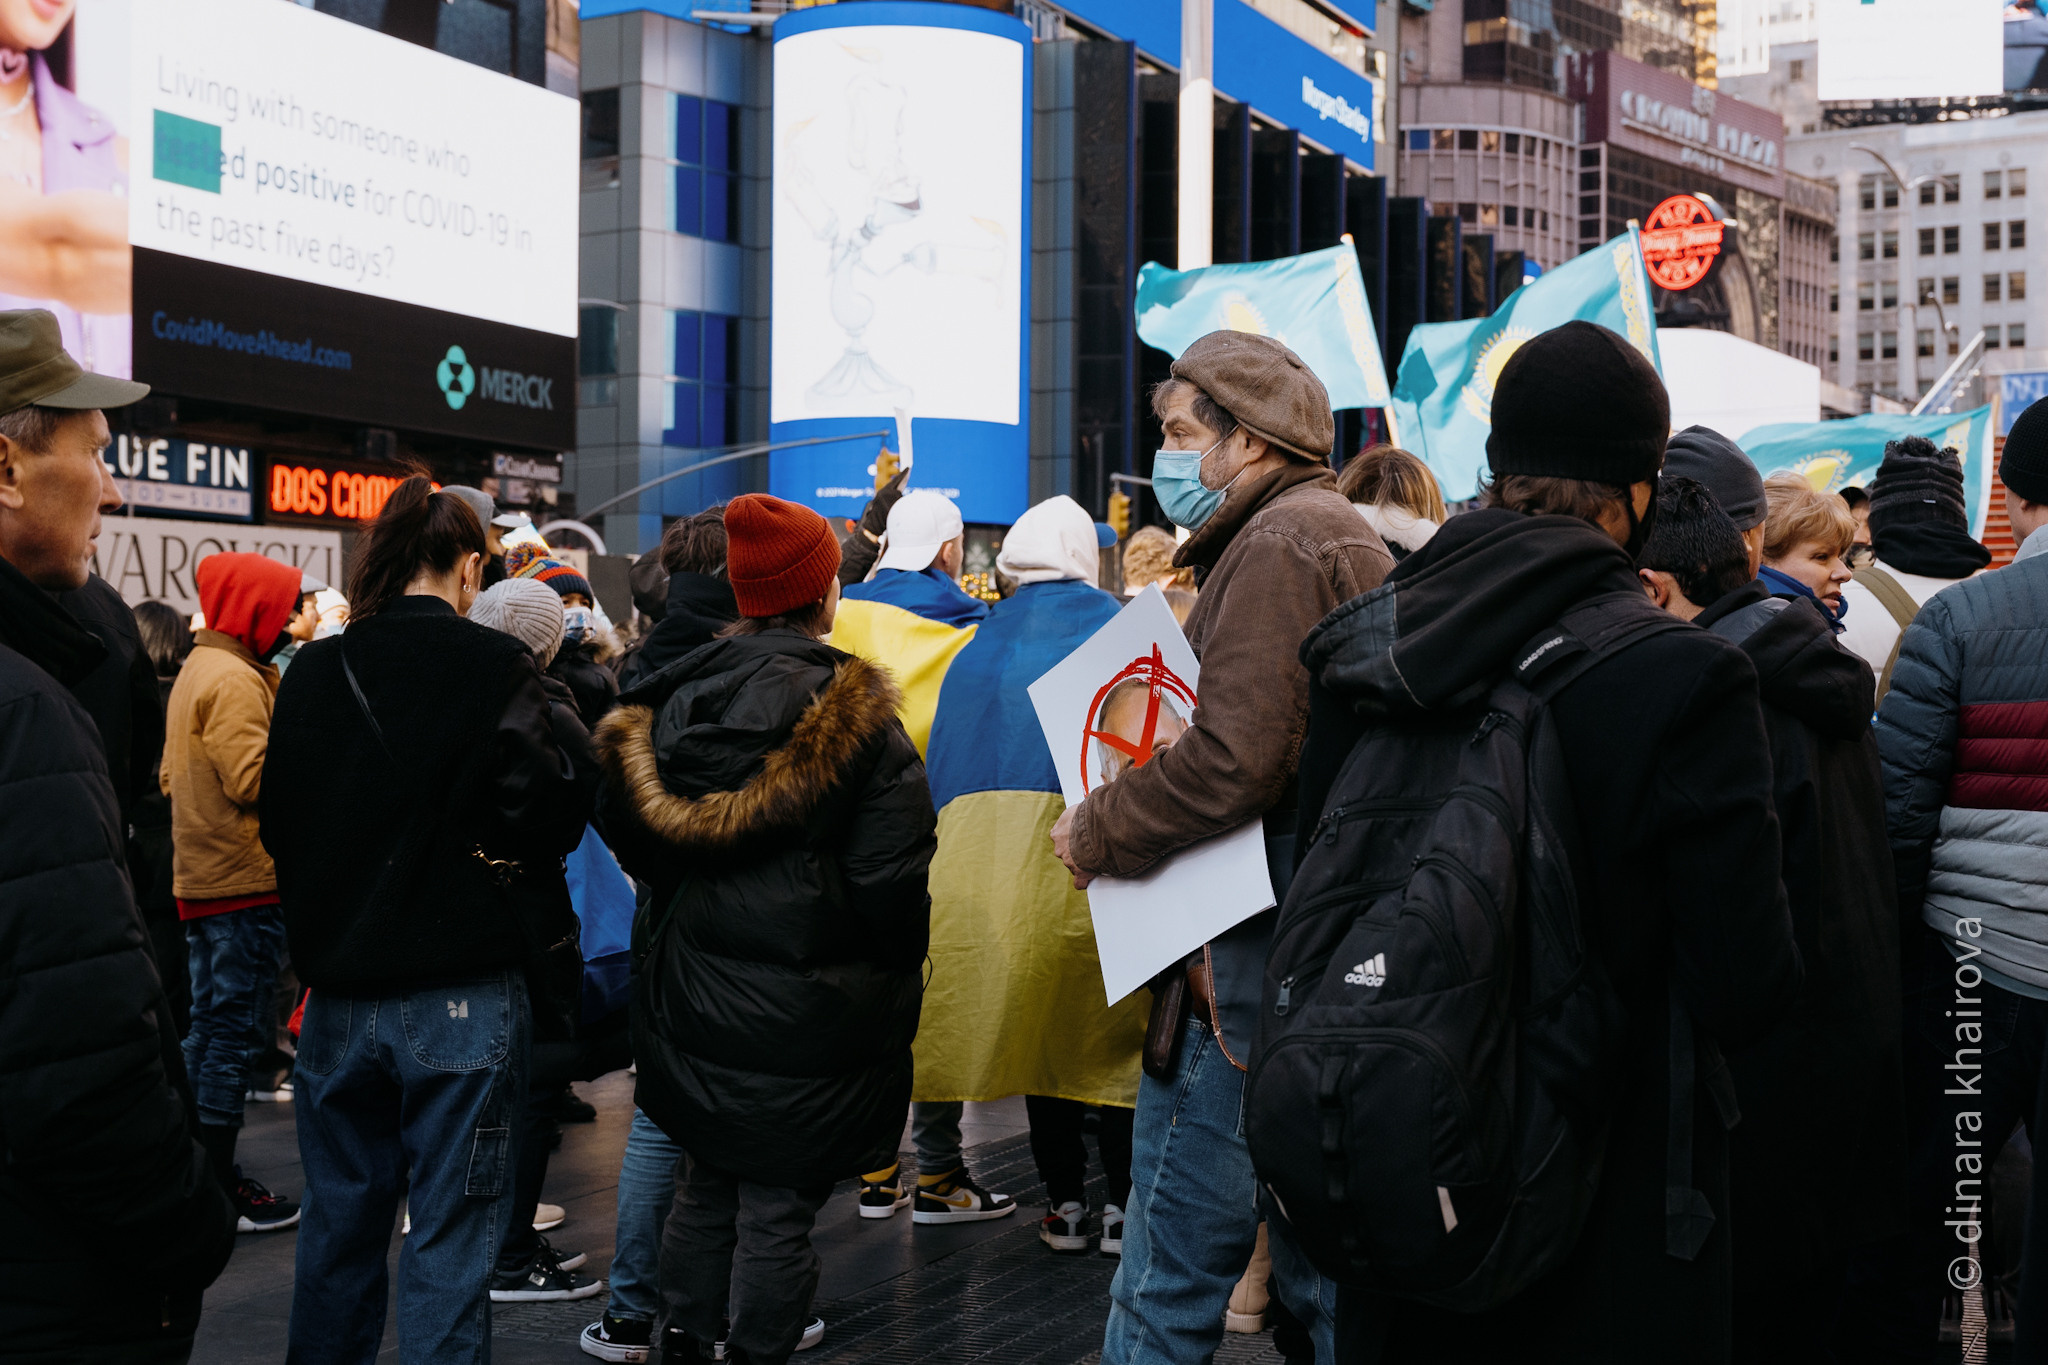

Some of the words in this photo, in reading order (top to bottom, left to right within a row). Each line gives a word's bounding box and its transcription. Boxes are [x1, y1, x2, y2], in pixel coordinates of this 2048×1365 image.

[158, 55, 238, 122] Living
[247, 89, 303, 131] with
[312, 111, 417, 163] someone
[426, 140, 470, 178] who
[256, 160, 356, 208] positive
[365, 178, 398, 217] for
[403, 189, 509, 246] COVID-19
[515, 219, 533, 252] in
[157, 195, 202, 237] the
[211, 216, 267, 252] past
[275, 219, 321, 264] five
[328, 234, 395, 283] days?
[151, 309, 353, 371] CovidMoveAhead.com
[480, 366, 554, 411] MERCK
[97, 433, 170, 481] LUE
[186, 441, 249, 489] FIN
[271, 463, 329, 517] DOS
[1344, 972, 1386, 988] adida
